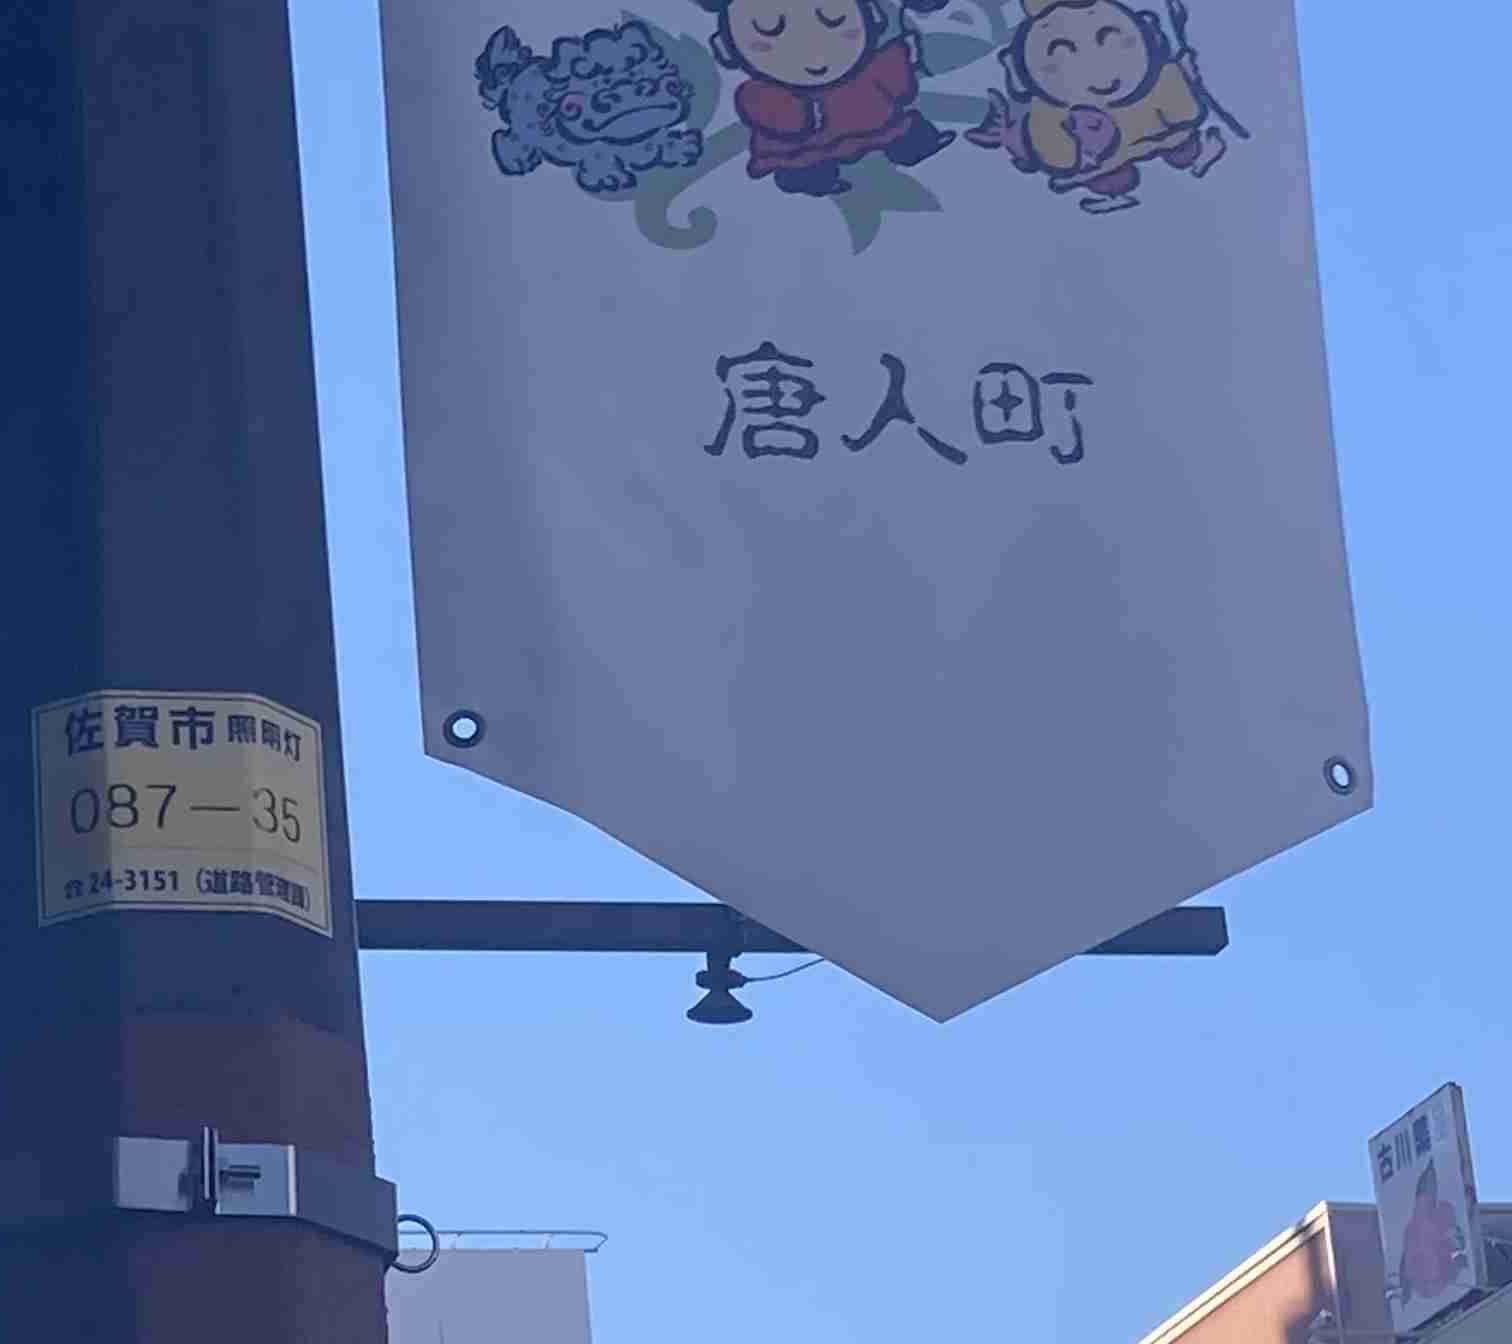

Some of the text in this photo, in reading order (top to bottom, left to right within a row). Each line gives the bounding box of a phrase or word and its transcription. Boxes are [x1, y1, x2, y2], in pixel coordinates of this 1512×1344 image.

[703, 341, 1094, 464] 唐人町
[64, 705, 216, 757] 佐賀市
